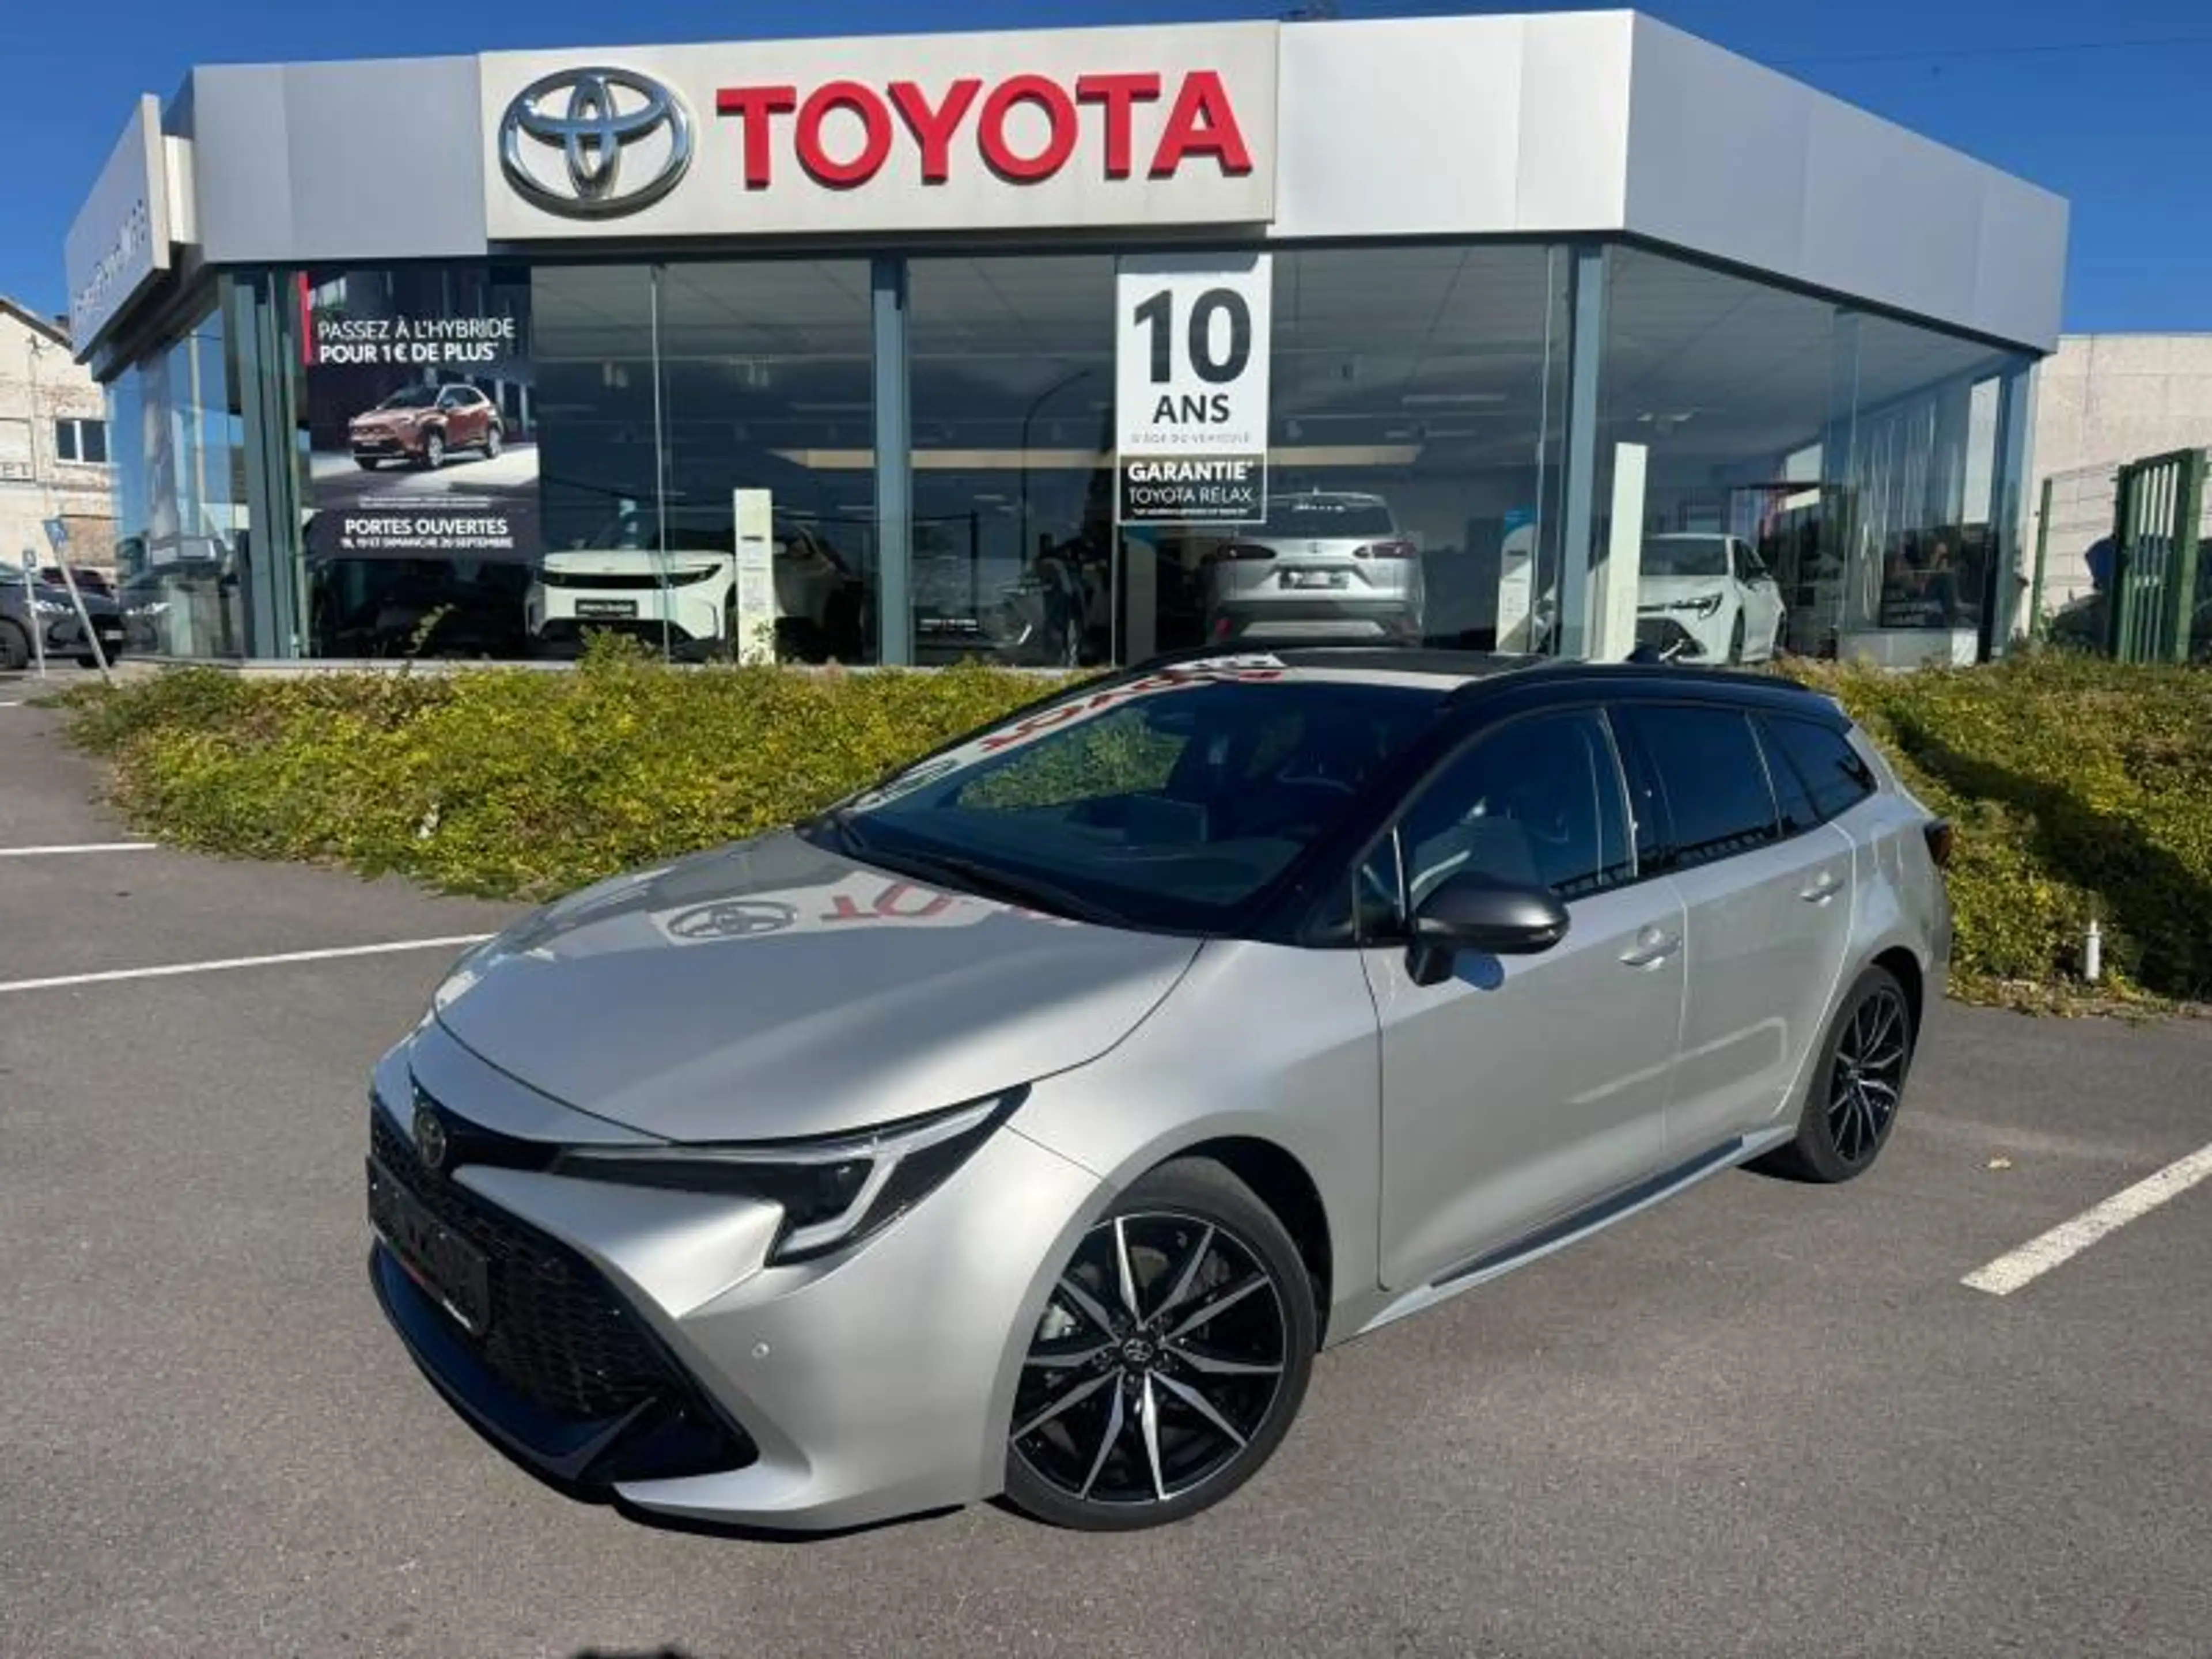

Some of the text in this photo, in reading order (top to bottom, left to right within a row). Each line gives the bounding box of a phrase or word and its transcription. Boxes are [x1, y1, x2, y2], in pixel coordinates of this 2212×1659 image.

[717, 71, 1252, 189] TOYOTA
[319, 316, 515, 339] PASSEZ À L'HYBRIDE
[1134, 287, 1251, 384] 10
[320, 345, 377, 363] POUR
[411, 343, 440, 362] DE
[1153, 393, 1230, 423] ANS
[1130, 487, 1253, 504] TOYOTA RELAX
[345, 518, 509, 535] PORTES OUVERTES
